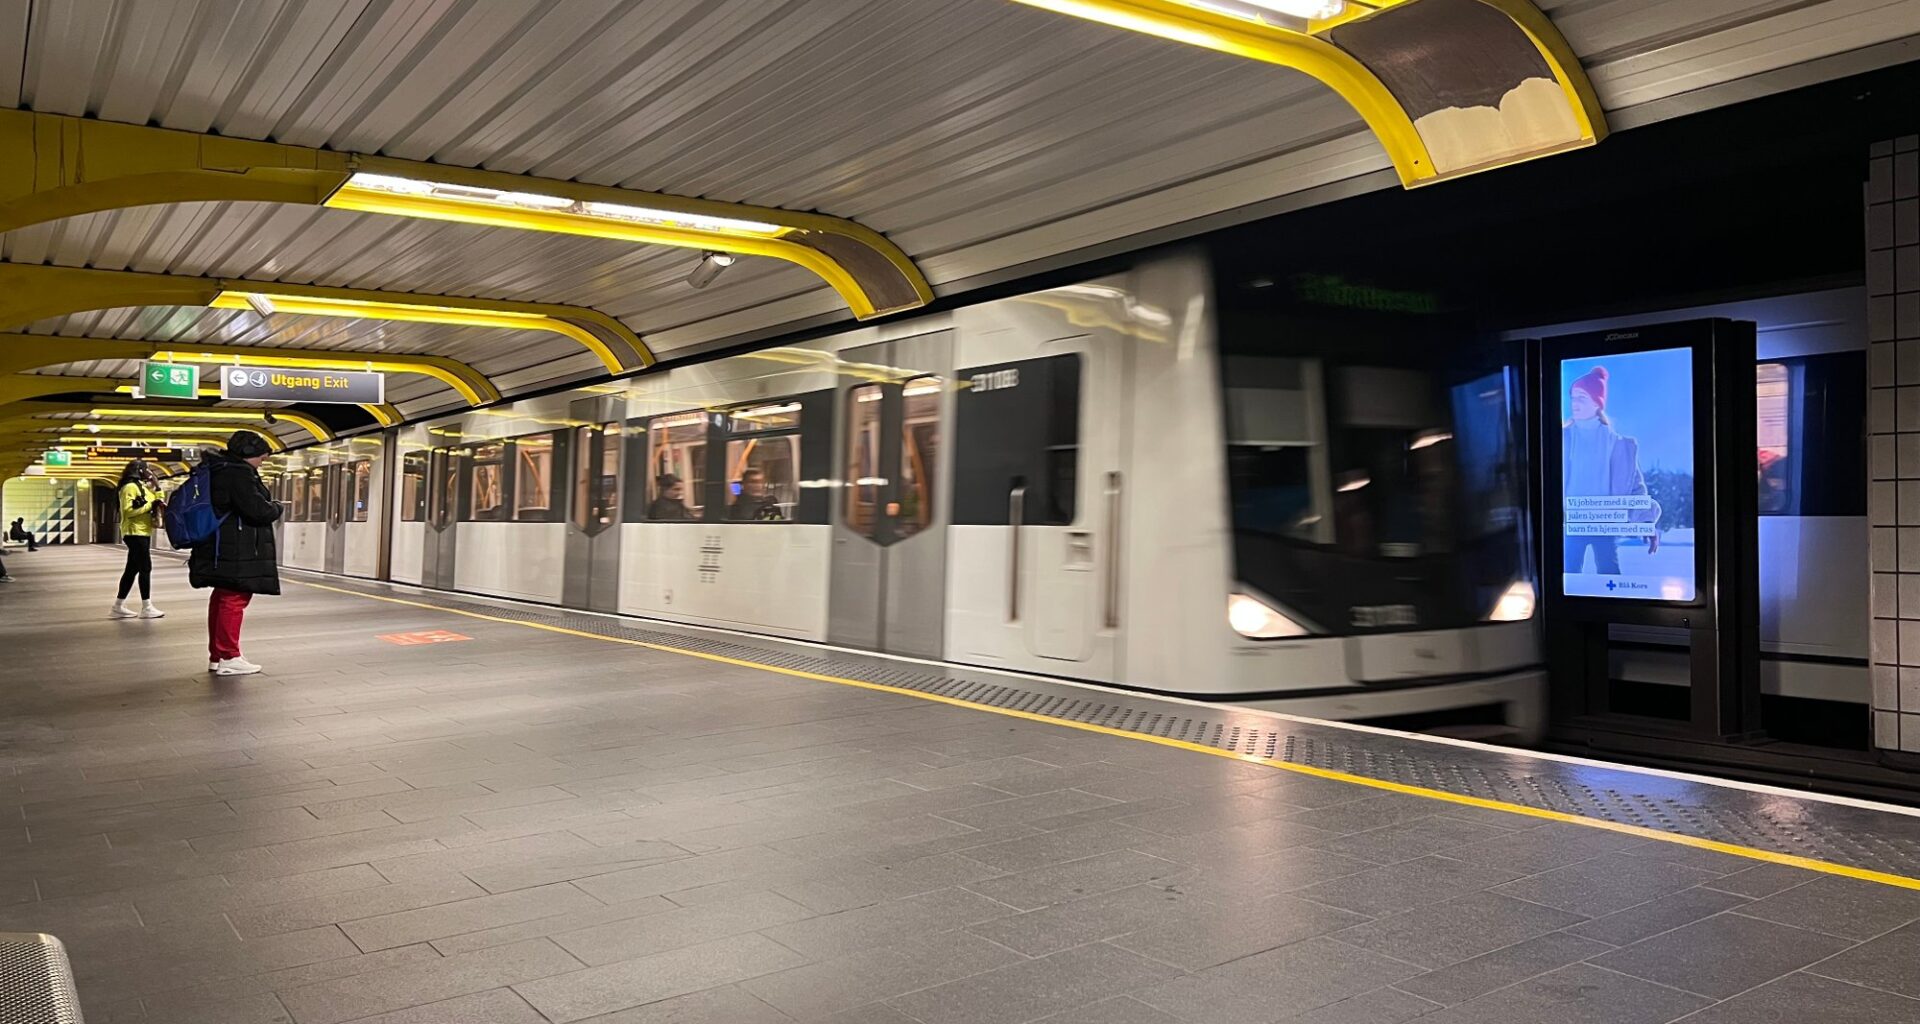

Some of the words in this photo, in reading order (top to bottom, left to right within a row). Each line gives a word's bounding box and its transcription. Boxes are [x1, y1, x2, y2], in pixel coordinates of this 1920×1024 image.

[271, 373, 321, 390] Utgang
[324, 375, 349, 388] Exit
[1568, 498, 1576, 506] Vi
[1578, 498, 1602, 508] jobber
[1622, 498, 1626, 506] å
[1628, 498, 1648, 508] gjøre
[1568, 512, 1588, 520] julen
[1590, 512, 1612, 520] lysere
[1614, 512, 1626, 520] for
[1568, 524, 1586, 532] barn
[1586, 524, 1598, 532] fra
[1600, 524, 1620, 534] hjem
